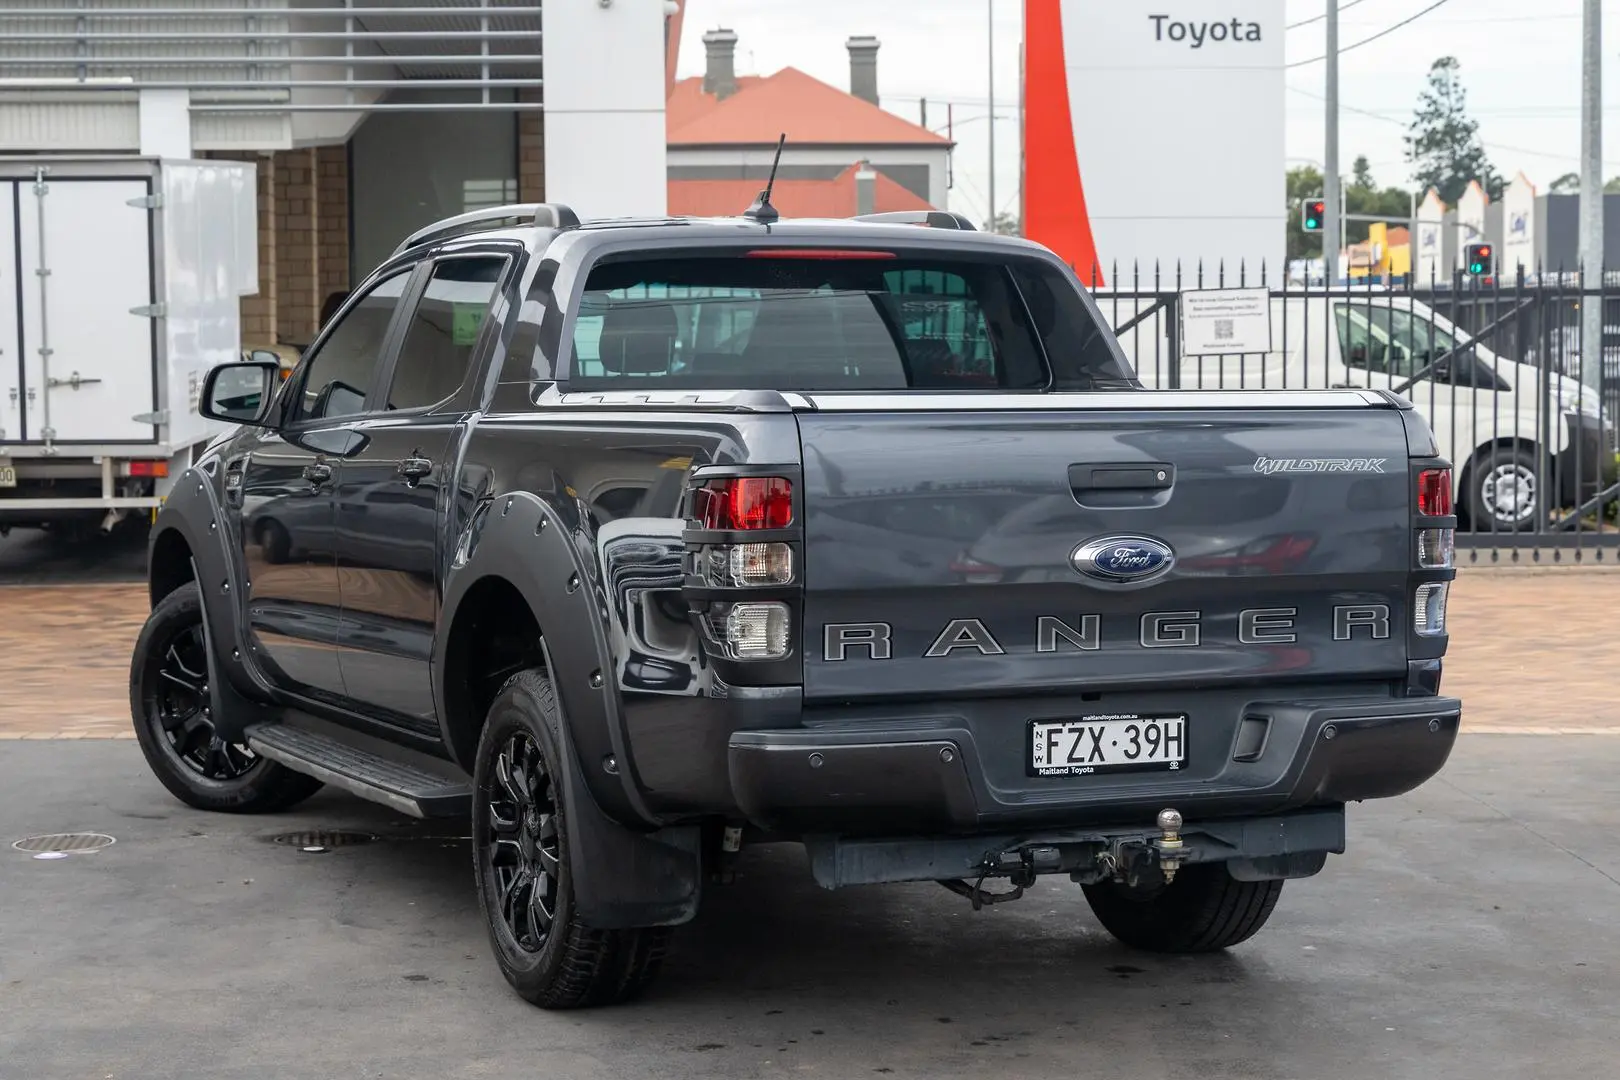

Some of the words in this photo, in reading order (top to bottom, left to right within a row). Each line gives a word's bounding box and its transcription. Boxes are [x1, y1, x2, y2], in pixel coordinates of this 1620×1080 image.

[1148, 15, 1261, 49] Toyota
[1253, 456, 1388, 475] WILDTRAK
[1110, 547, 1151, 568] Ford
[822, 603, 1392, 662] RANGER
[1083, 713, 1138, 721] maitlandtoyota.com.au
[1039, 767, 1069, 776] Maitland
[1071, 766, 1095, 775] Toyota
